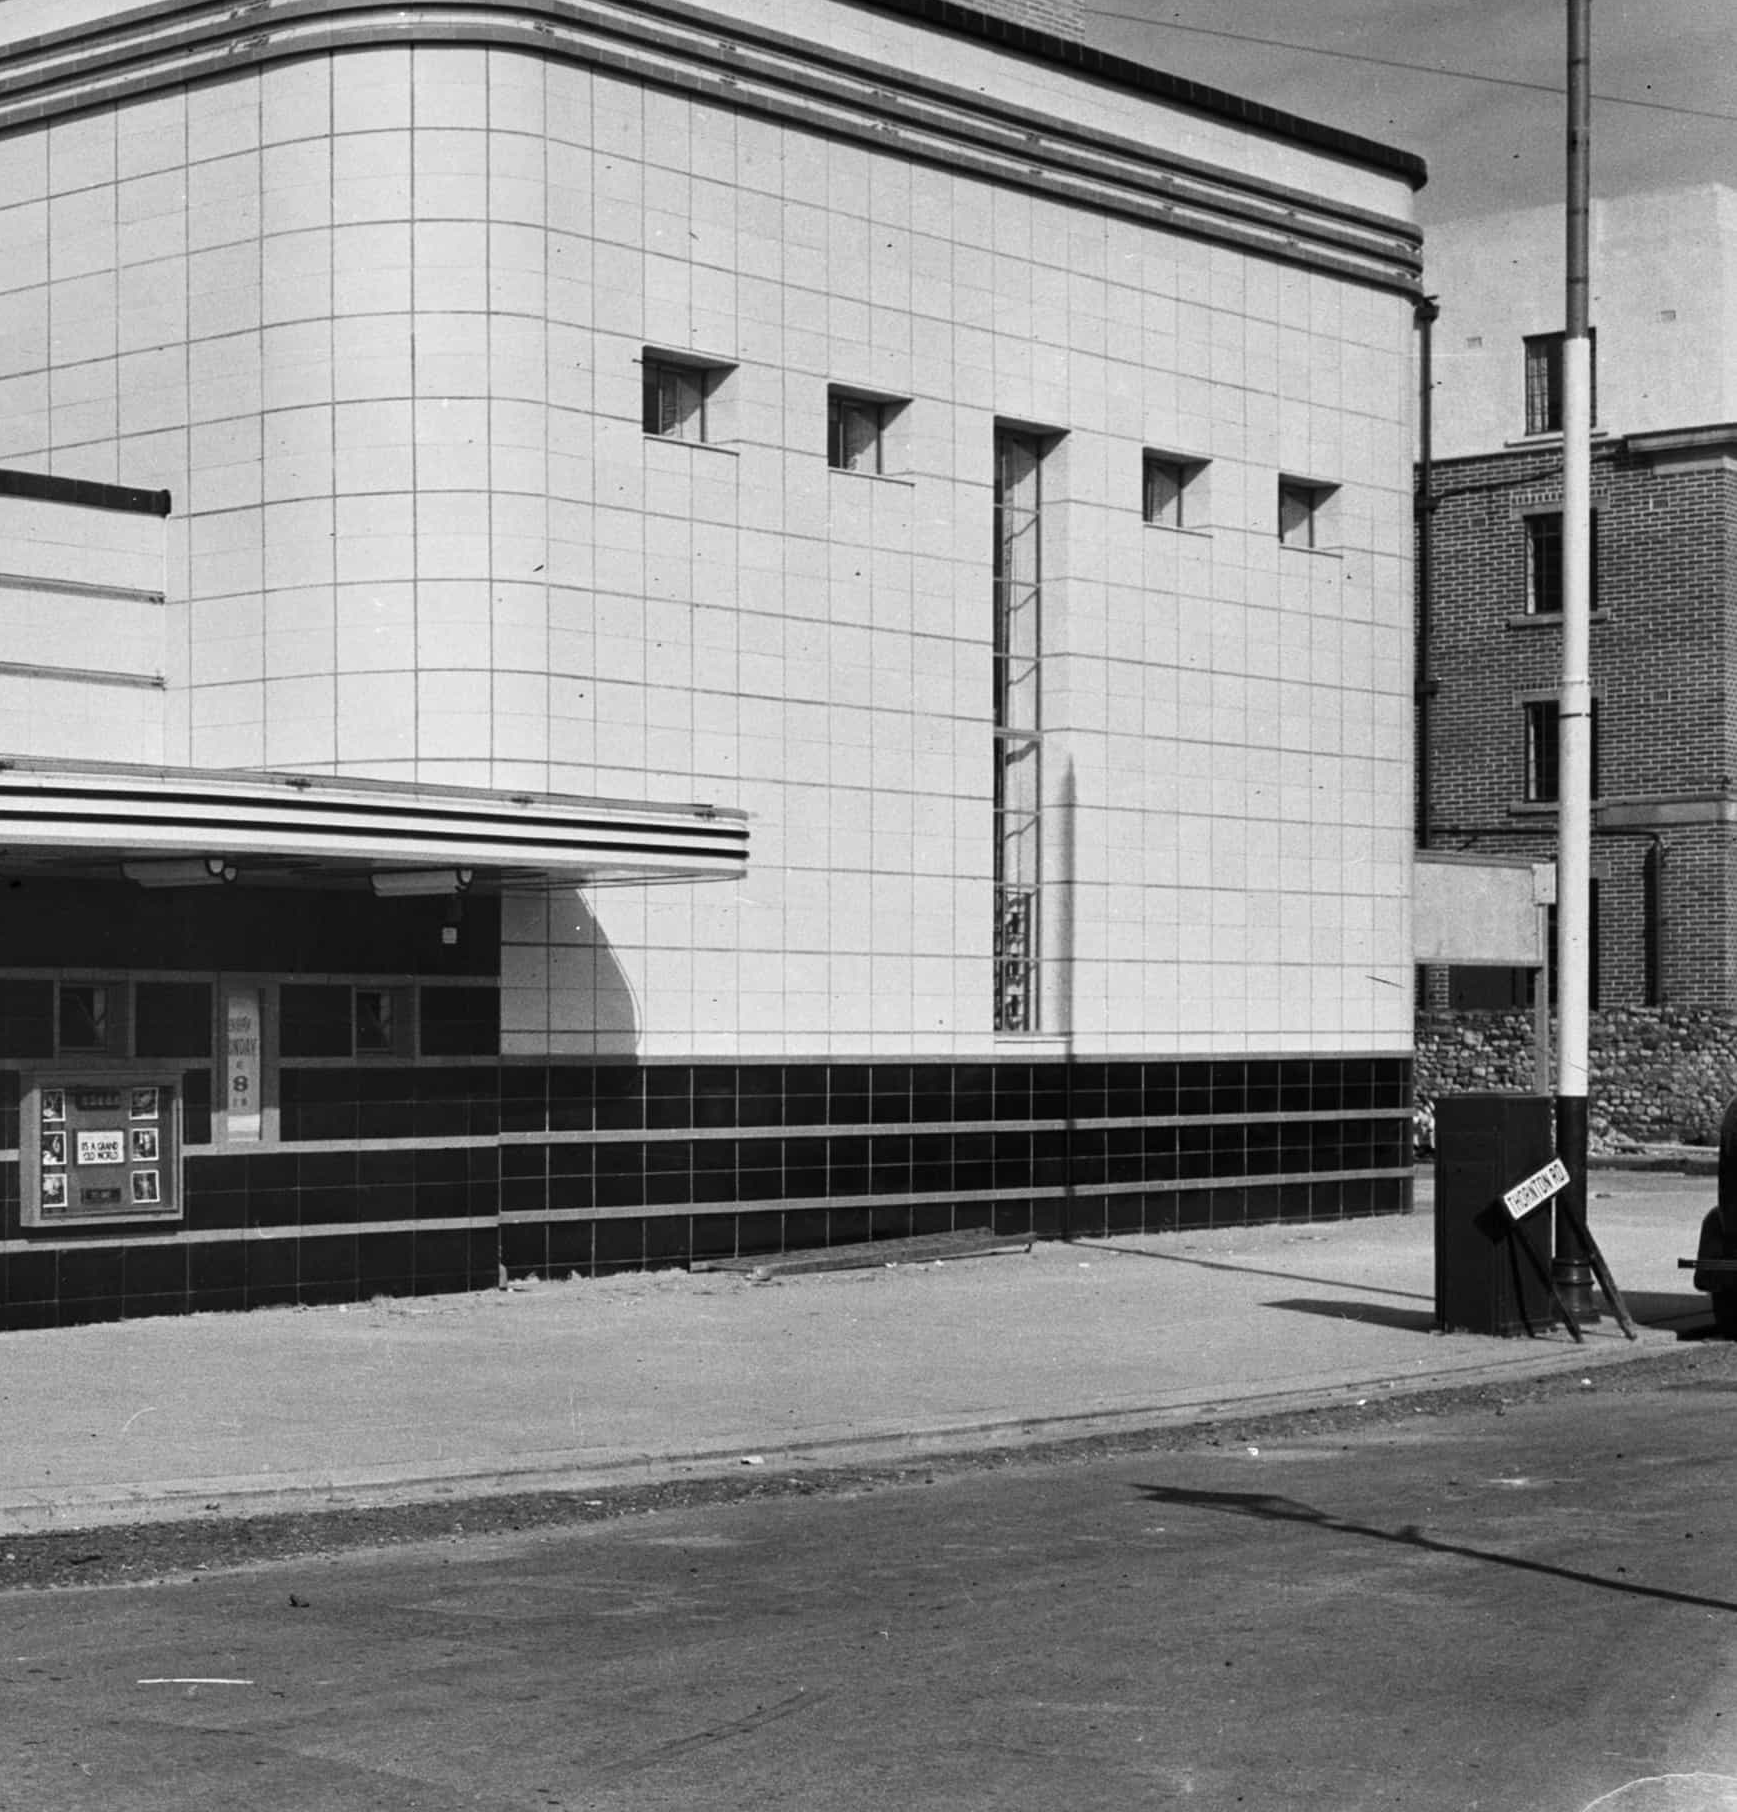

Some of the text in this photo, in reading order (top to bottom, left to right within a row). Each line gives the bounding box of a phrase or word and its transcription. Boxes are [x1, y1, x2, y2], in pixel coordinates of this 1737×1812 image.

[232, 1075, 249, 1092] 8
[1506, 1163, 1566, 1215] THORNTON RD
